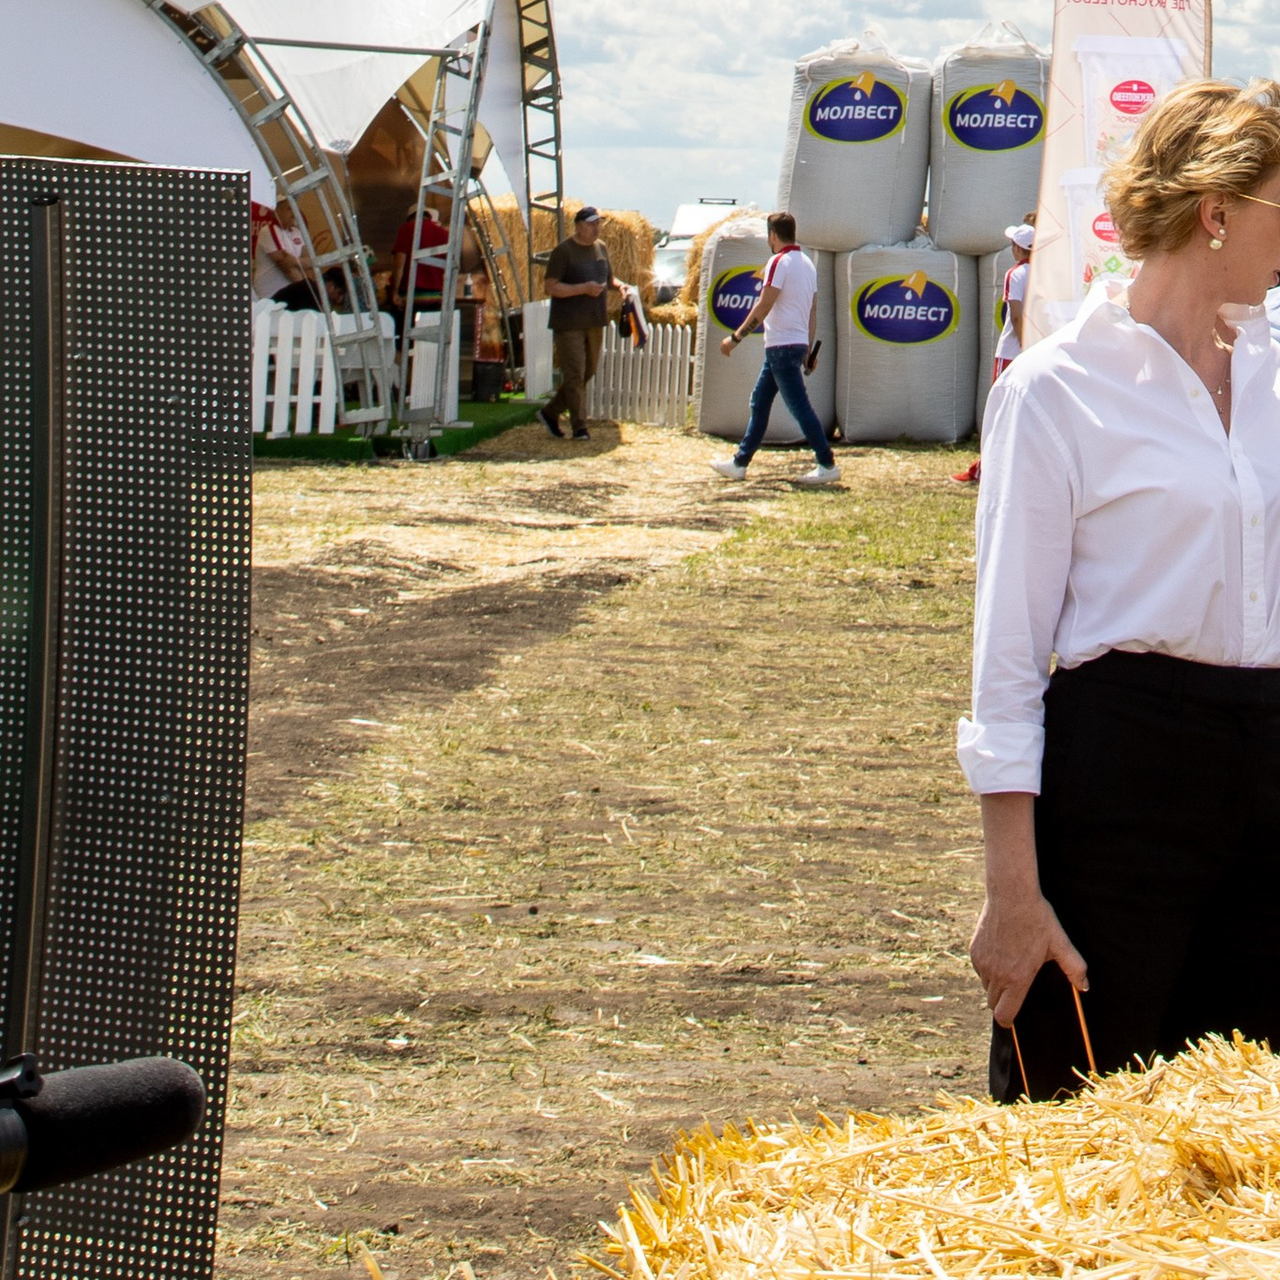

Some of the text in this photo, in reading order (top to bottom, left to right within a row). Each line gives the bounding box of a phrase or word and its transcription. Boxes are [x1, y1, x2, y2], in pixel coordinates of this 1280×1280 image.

[816, 105, 898, 122] МОЛВЕСТ
[956, 113, 1038, 129] МОЛВЕСТ
[717, 293, 761, 309] МОЛ
[864, 304, 948, 322] МОЛВЕСТ
